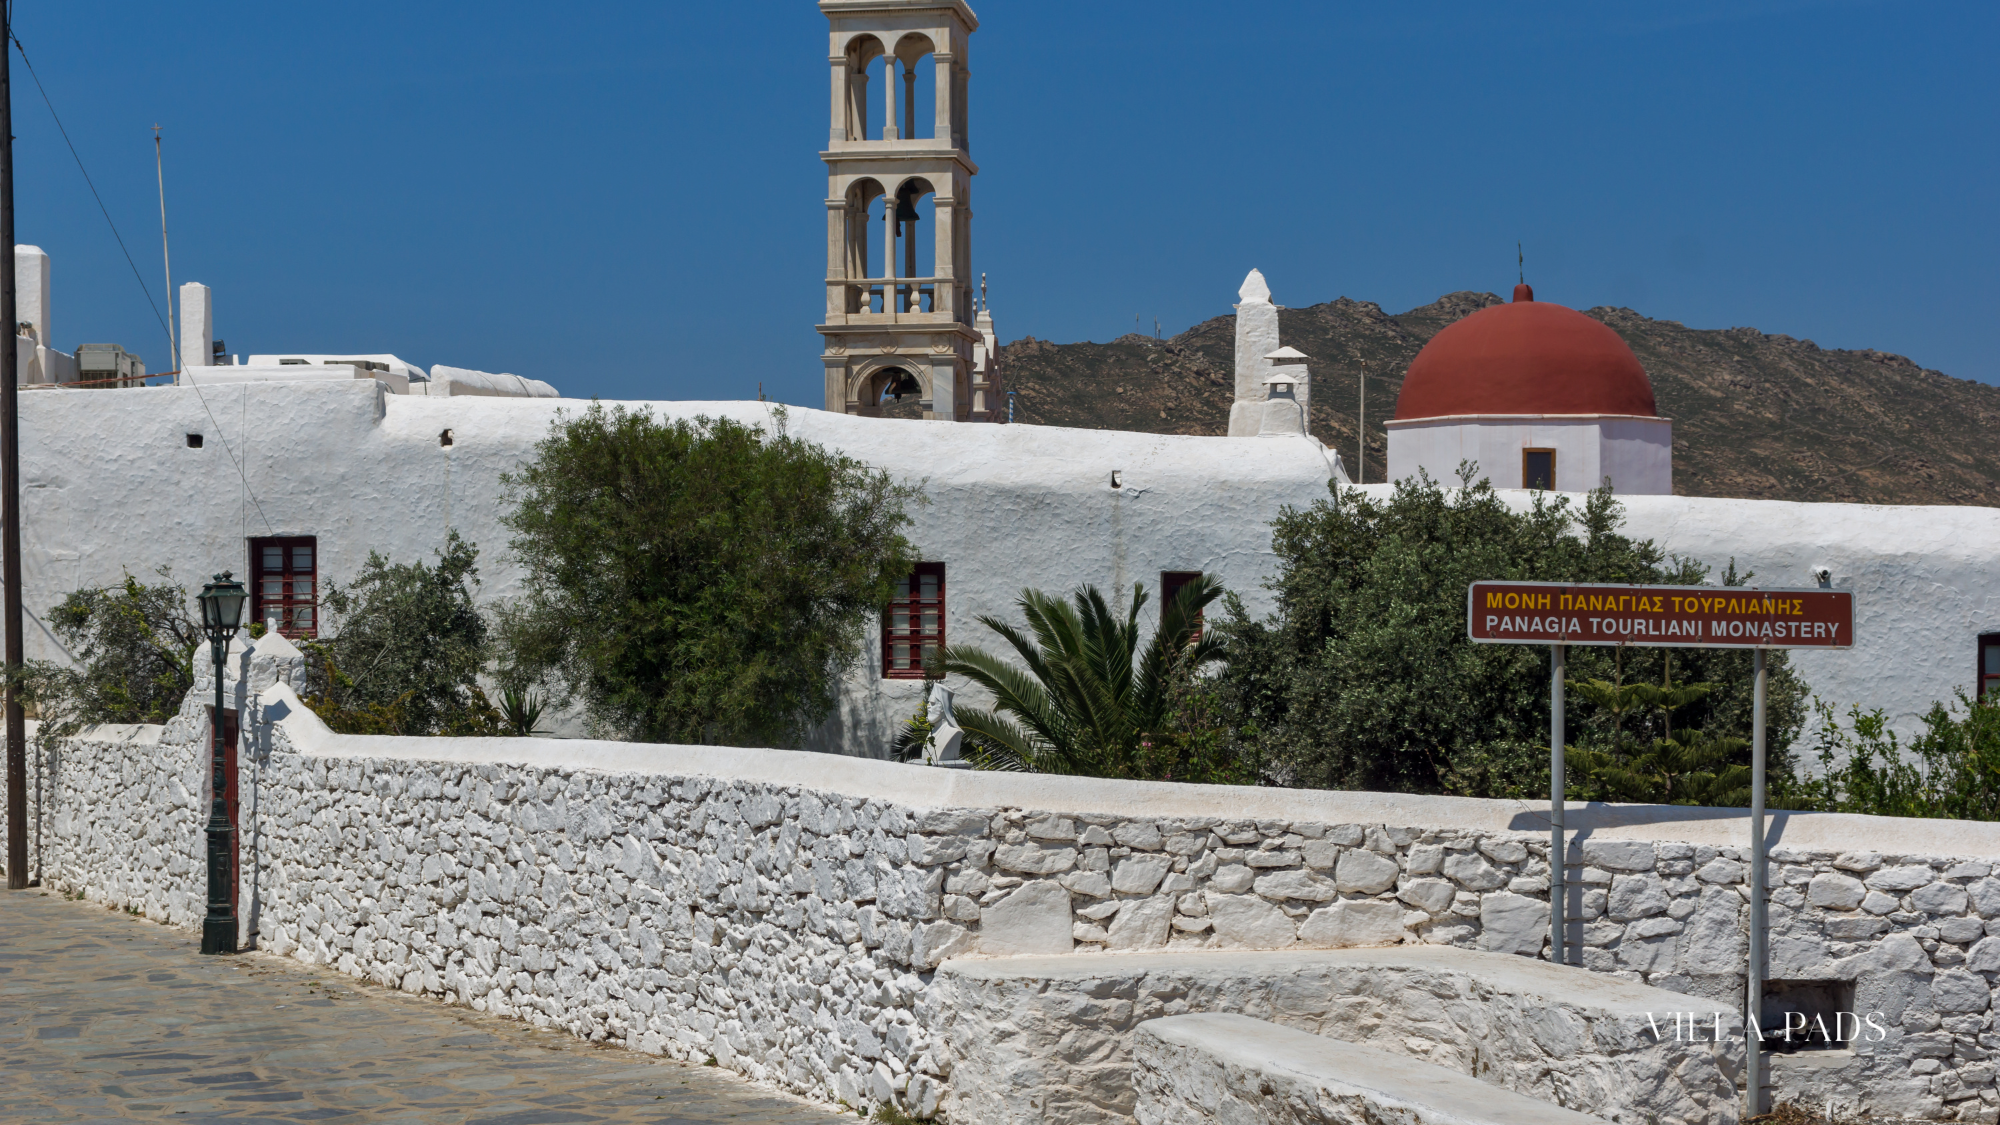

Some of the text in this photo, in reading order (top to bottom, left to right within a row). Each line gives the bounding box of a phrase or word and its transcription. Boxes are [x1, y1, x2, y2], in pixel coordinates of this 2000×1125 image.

[1486, 592, 1803, 615] ΜΟΝΗ ΠΑΝΑΓΙΑΣ ΤΟΥΡΛΙΑΝΗΣ
[1486, 615, 1839, 638] PANAGIA TOURLIANI MONASTERY
